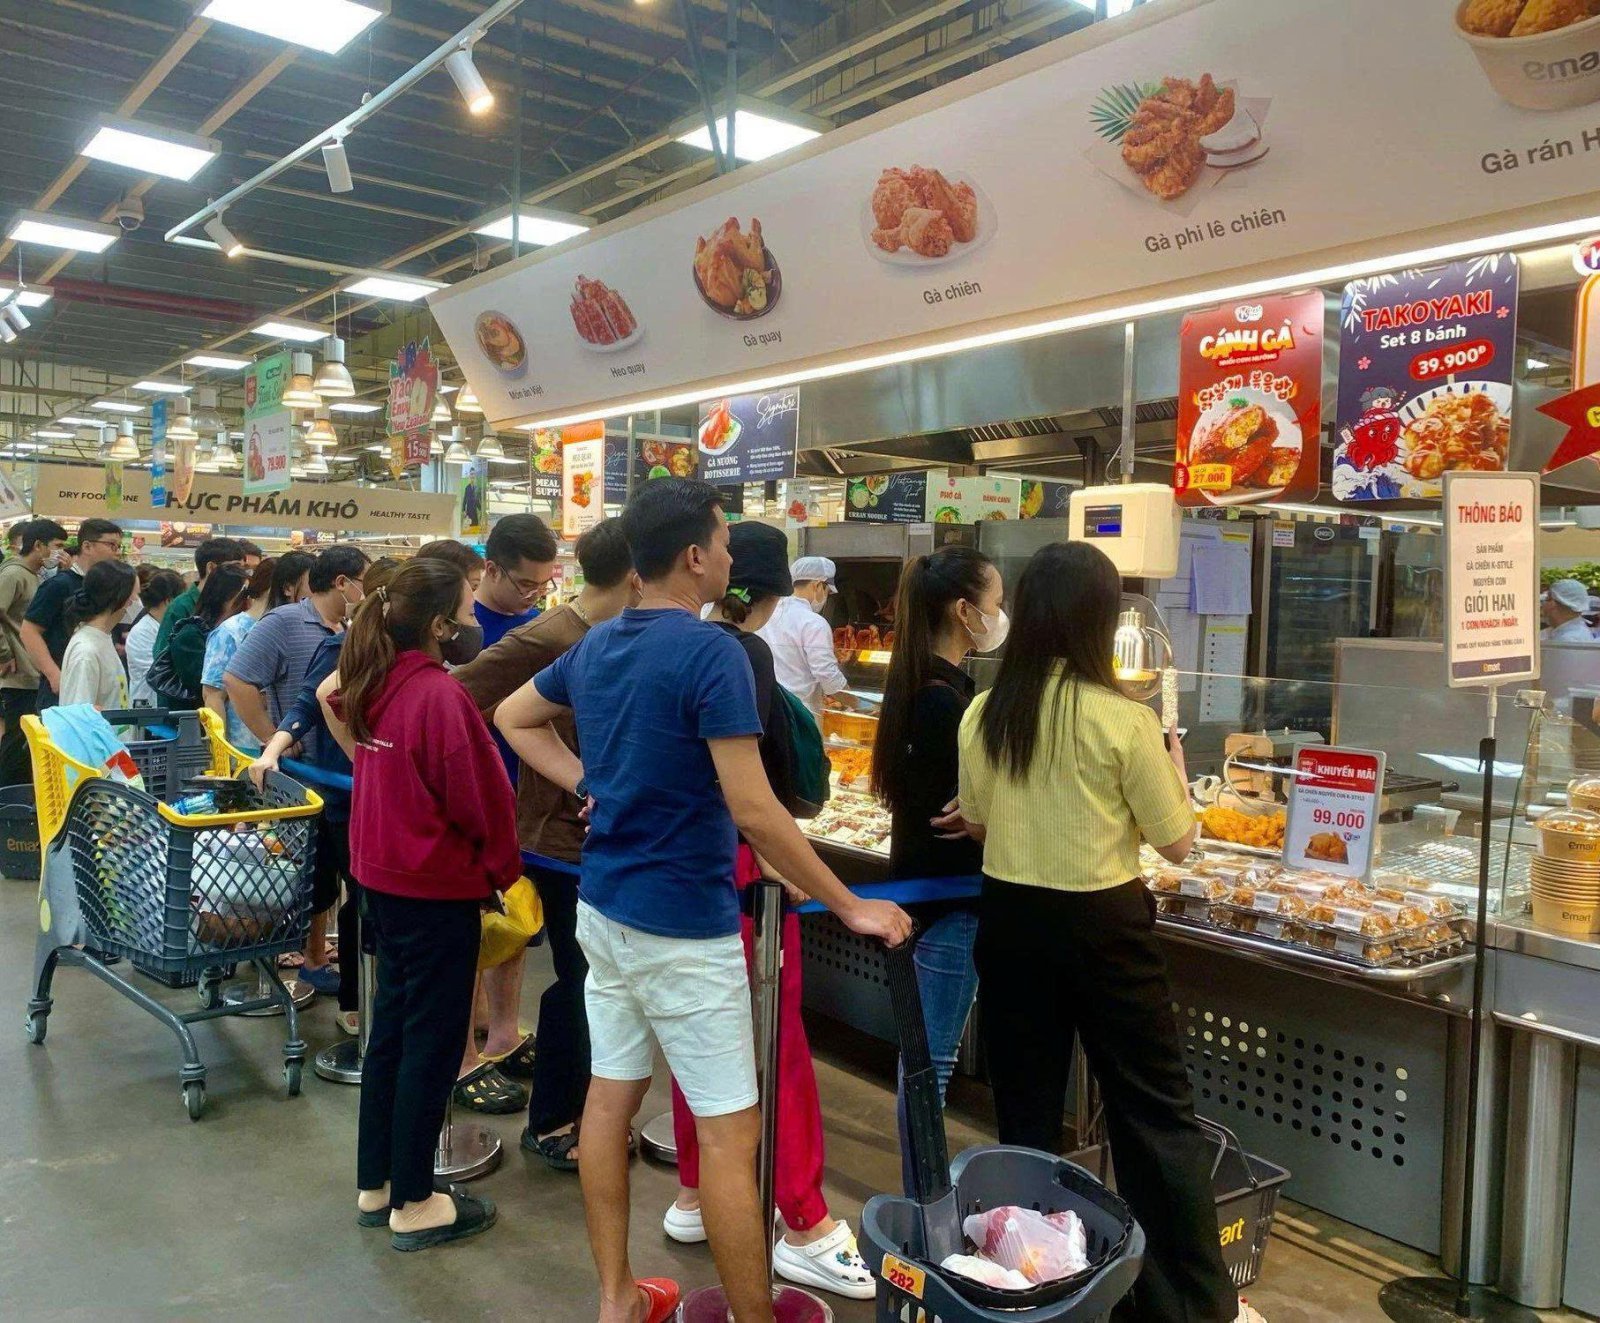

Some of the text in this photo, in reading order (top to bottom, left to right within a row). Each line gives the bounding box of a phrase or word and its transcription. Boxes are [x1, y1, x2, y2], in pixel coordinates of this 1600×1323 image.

[1481, 149, 1519, 174] Gà
[1527, 139, 1574, 164] rán
[1144, 208, 1287, 253] Gà phi lê chiên
[923, 281, 982, 305] Gà chiên
[1361, 289, 1493, 332] TAKOYAKI
[743, 330, 782, 348] Gà quay
[1200, 318, 1296, 360] CÁNH GÀ
[1380, 324, 1467, 349] Set 8 bánh
[610, 362, 646, 378] Heo quay
[535, 478, 560, 488] MEAL
[59, 490, 79, 499] DRY
[81, 491, 107, 501] FOO
[306, 499, 359, 519] KHÔ
[370, 510, 431, 521] HEALTHY TASTE
[1458, 501, 1523, 523] THÔNG BÁO
[1466, 560, 1514, 571] GÀ CHIÊN K-STYLE
[1495, 577, 1507, 586] CON
[1464, 589, 1515, 617] GIỚI HẠN
[1317, 763, 1377, 780] KHUYẾN MÃI
[1313, 808, 1366, 829] 99.000
[1568, 841, 1598, 851] emart
[1561, 910, 1592, 922] emart
[1219, 1217, 1245, 1247] art
[889, 1268, 915, 1293] 282
